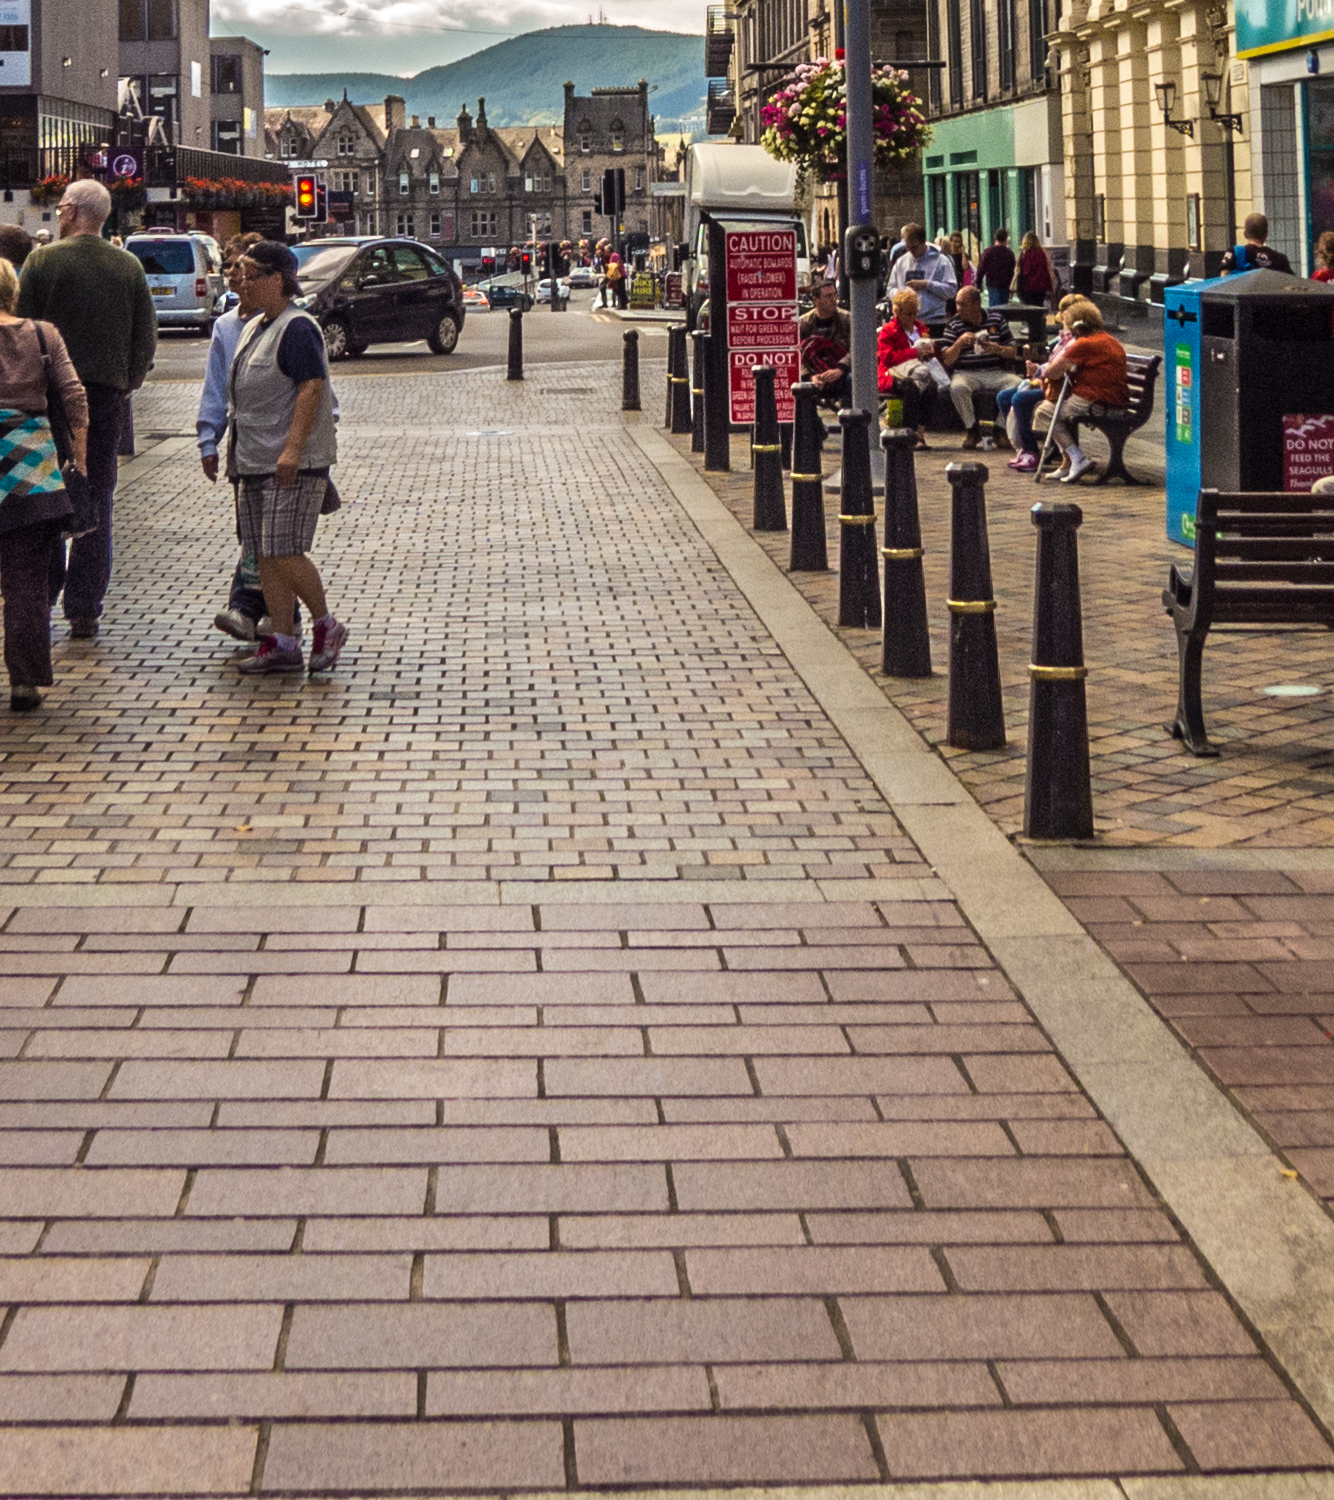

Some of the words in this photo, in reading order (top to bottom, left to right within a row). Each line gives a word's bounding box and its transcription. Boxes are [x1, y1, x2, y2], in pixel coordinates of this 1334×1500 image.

[729, 235, 793, 251] CAUTION
[742, 288, 749, 298] IN
[750, 287, 783, 298] OPERATION
[735, 307, 793, 320] STOP
[746, 324, 757, 333] FOR
[758, 324, 779, 333] GREEN
[779, 323, 796, 333] LIGHT
[732, 335, 755, 345] BEFORE
[756, 334, 795, 344] PROCEEDING
[735, 353, 757, 366] DO
[762, 352, 794, 365] NOT
[1286, 439, 1306, 450] DO
[1308, 438, 1334, 450] NOT
[1290, 453, 1312, 463] FEED
[1313, 453, 1330, 462] THE
[1289, 466, 1333, 475] SEAGULLS
